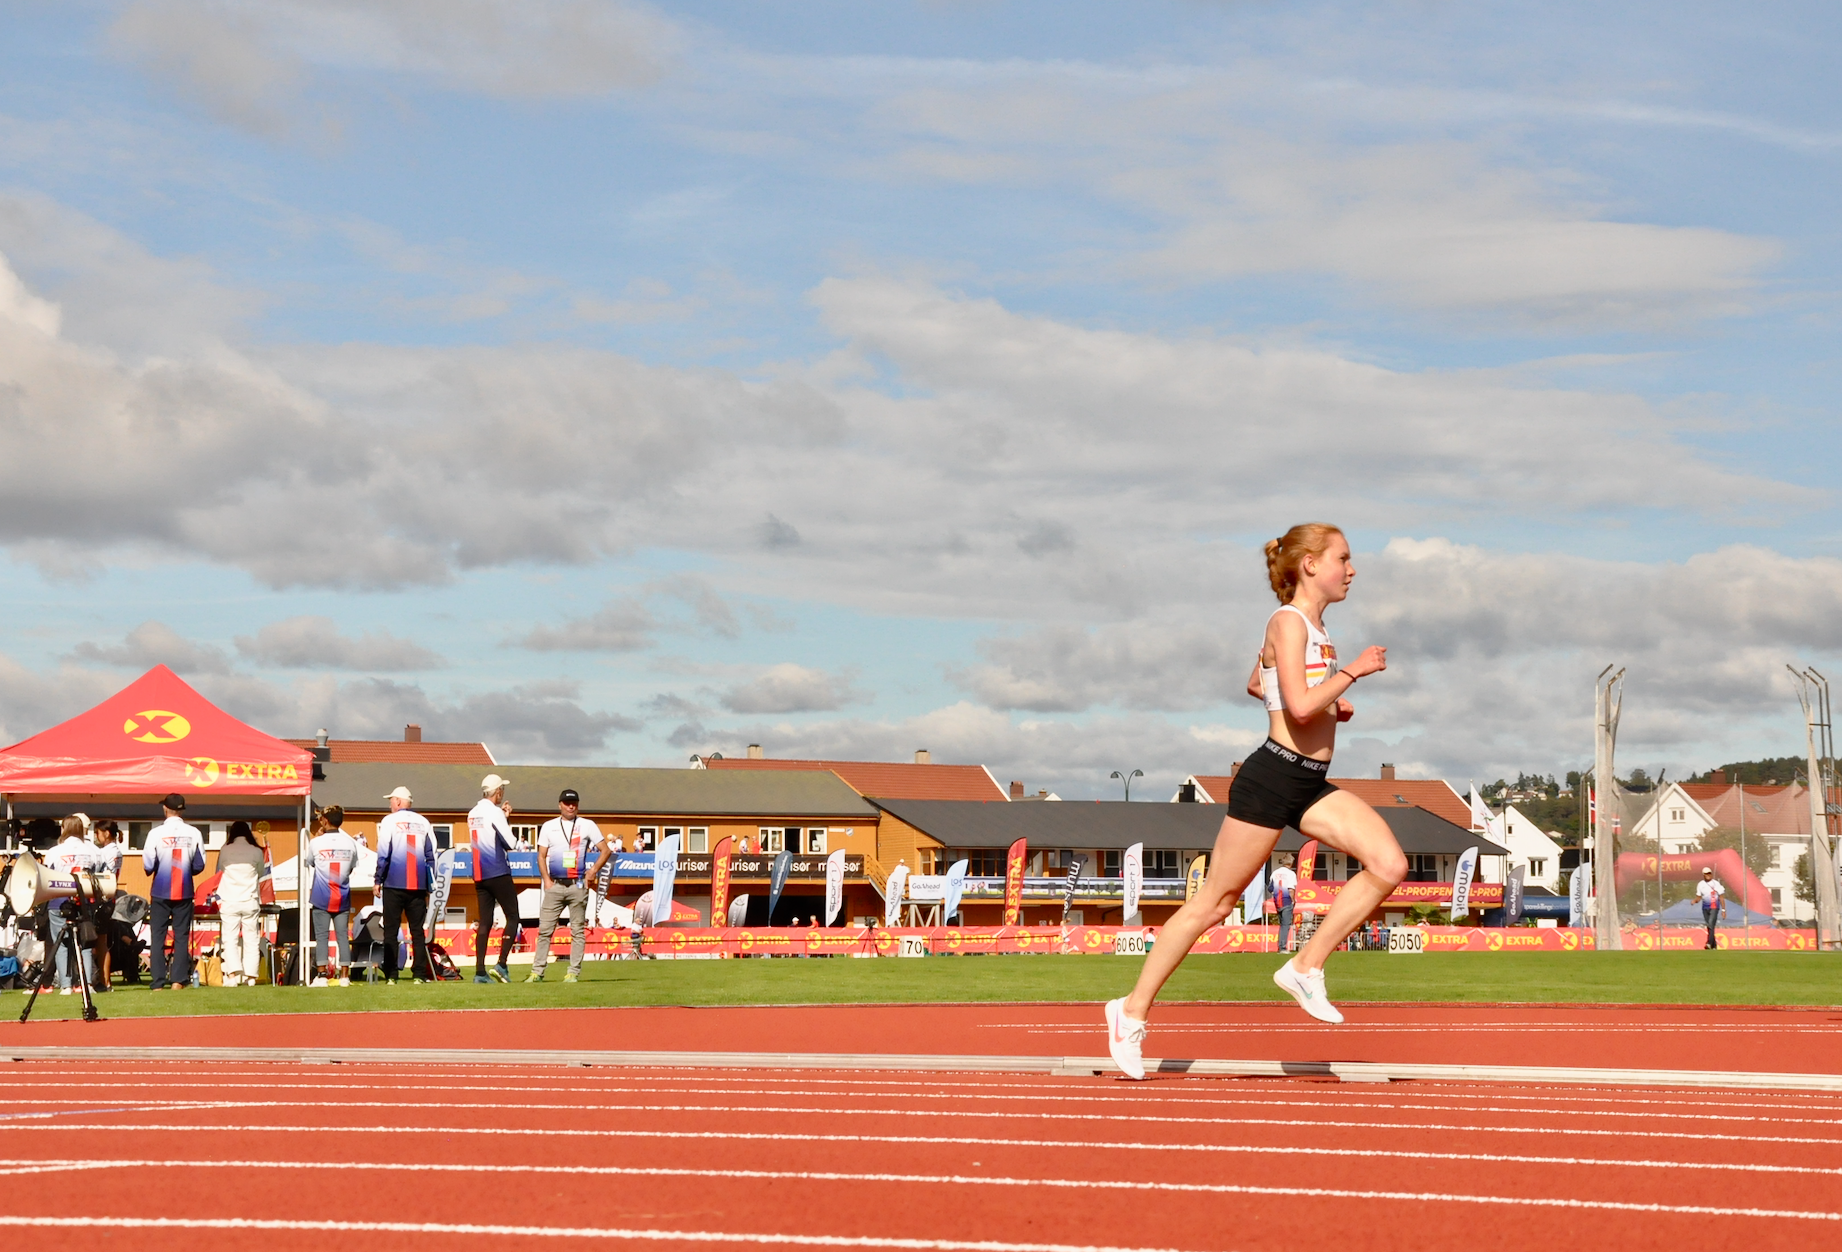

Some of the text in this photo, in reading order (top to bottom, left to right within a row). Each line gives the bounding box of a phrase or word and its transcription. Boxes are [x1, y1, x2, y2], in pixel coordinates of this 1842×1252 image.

[1265, 740, 1281, 754] NIKE
[1278, 749, 1298, 763] PRO
[1301, 760, 1320, 771] NIKE
[226, 764, 299, 780] EXTRA
[676, 858, 709, 871] urisør
[729, 859, 760, 871] urisør
[1660, 860, 1692, 872] EXTRA
[715, 855, 728, 909] EXTRA
[1009, 856, 1022, 906] EXTRA
[1455, 872, 1468, 912] mobit
[1510, 878, 1518, 916] GoAhead
[433, 937, 453, 947] TRA
[688, 936, 723, 945] EXTRA
[756, 936, 791, 945] EXTRA
[824, 936, 859, 945] EXTRA
[964, 935, 999, 944] EXTRA
[1432, 934, 1469, 944] EXTRA
[1506, 936, 1544, 946] EXTRA
[1656, 936, 1694, 946] EXTRA
[1731, 937, 1770, 947] EXTRA
[906, 940, 922, 954] 70
